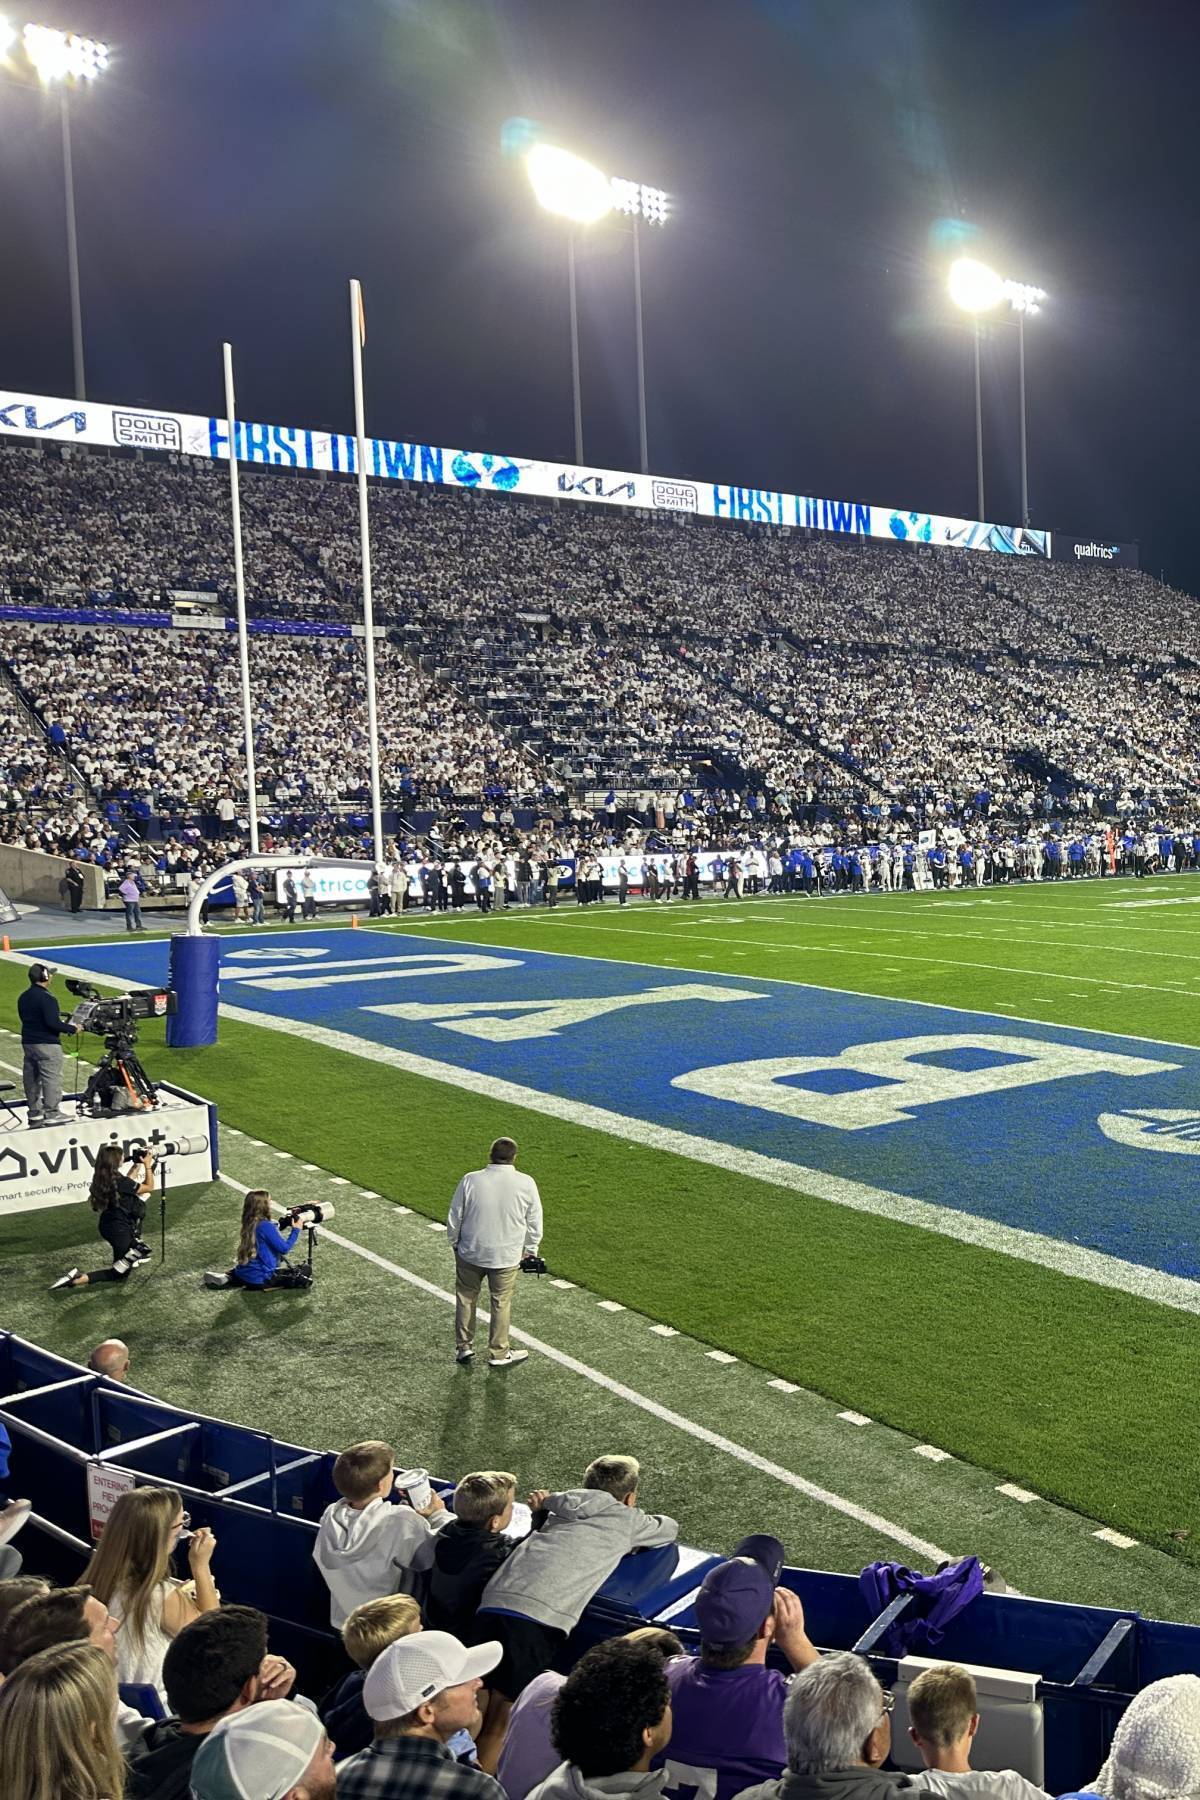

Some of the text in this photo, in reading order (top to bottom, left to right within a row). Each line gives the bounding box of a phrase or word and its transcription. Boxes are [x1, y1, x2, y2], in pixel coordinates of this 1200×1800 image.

[119, 417, 175, 433] DOUG
[656, 485, 694, 498] DOUG
[1074, 541, 1113, 560] qualtrics
[0, 1191, 22, 1201] mart
[93, 1475, 129, 1492] ENTERING
[102, 1491, 120, 1504] FIEL
